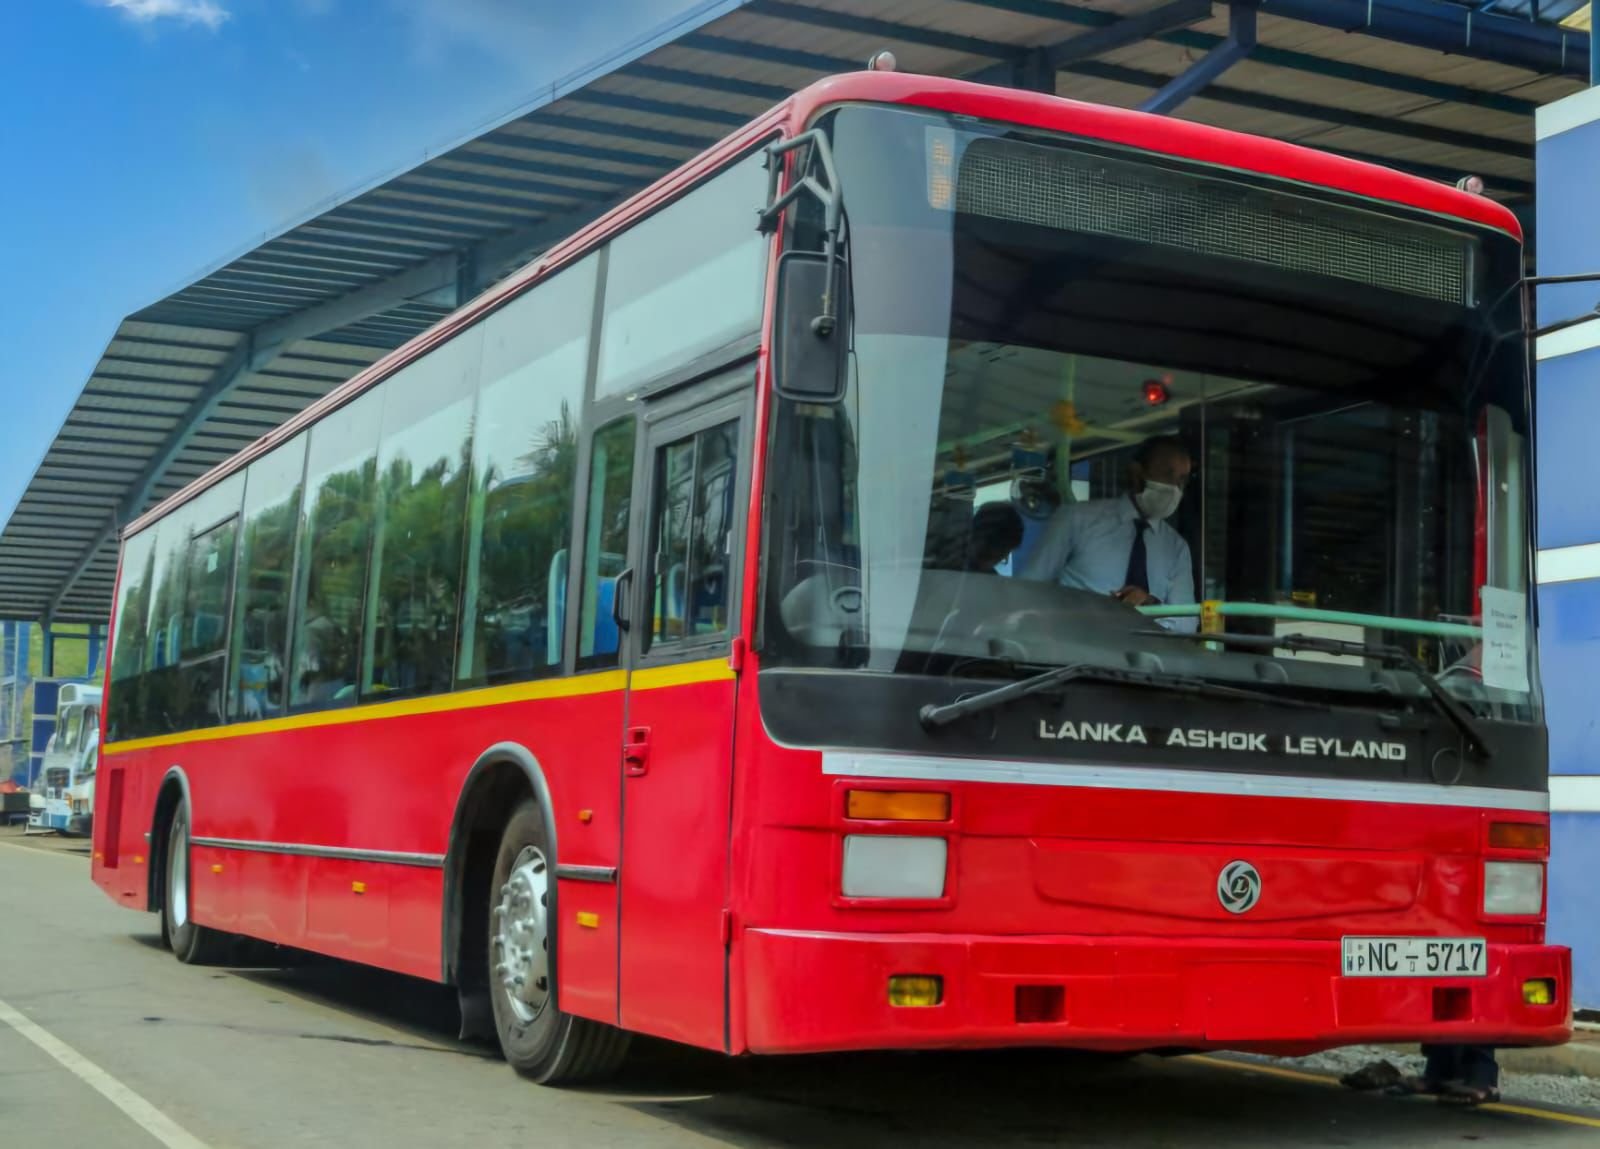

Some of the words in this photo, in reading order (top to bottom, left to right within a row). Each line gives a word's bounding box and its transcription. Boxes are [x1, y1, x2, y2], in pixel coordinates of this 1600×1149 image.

[1039, 719, 1147, 744] LANKA
[1166, 727, 1268, 753] ASHOK
[1285, 735, 1406, 761] LEYLAND
[1426, 943, 1483, 973] 5717
